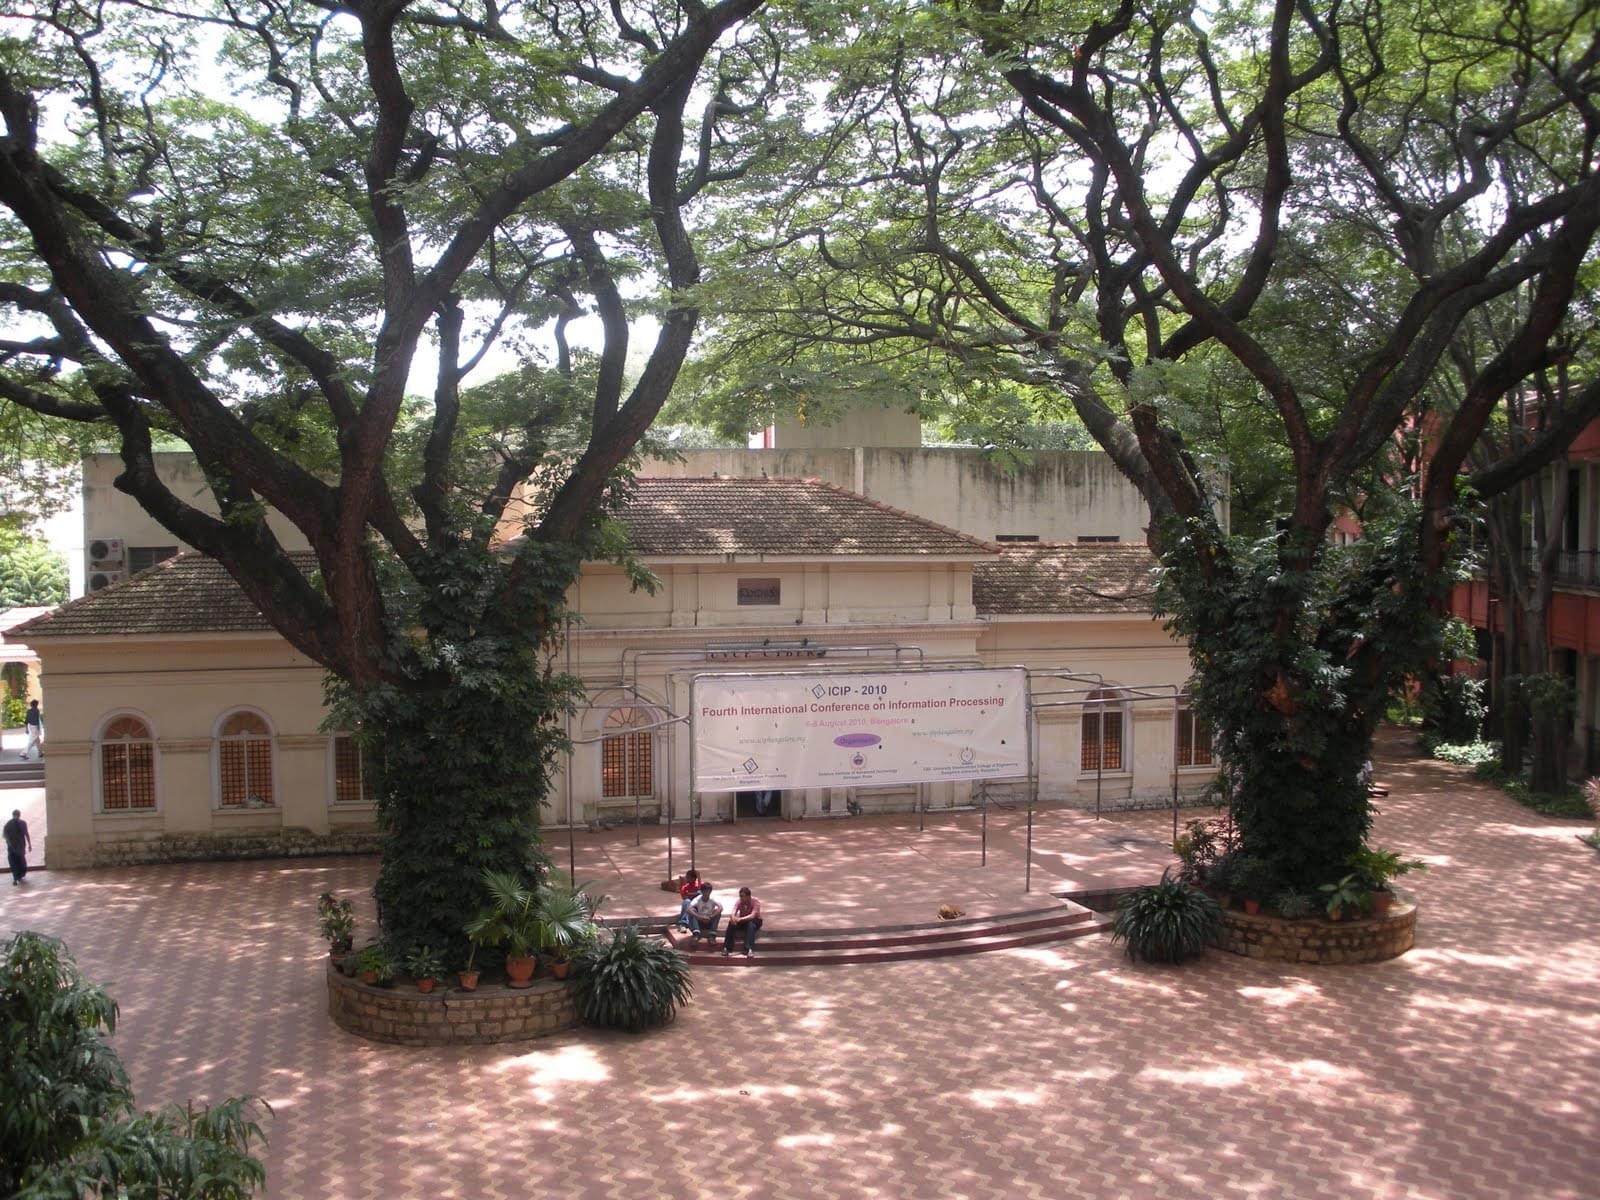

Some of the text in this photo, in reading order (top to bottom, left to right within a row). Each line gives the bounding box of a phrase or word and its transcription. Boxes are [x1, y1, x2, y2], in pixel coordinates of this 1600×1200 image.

[828, 686, 851, 696] ICIP
[861, 685, 887, 695] 2010
[702, 696, 1005, 717] Fourth International Conference on Information Processing
[819, 719, 846, 729] August
[870, 717, 908, 727] Bangalore
